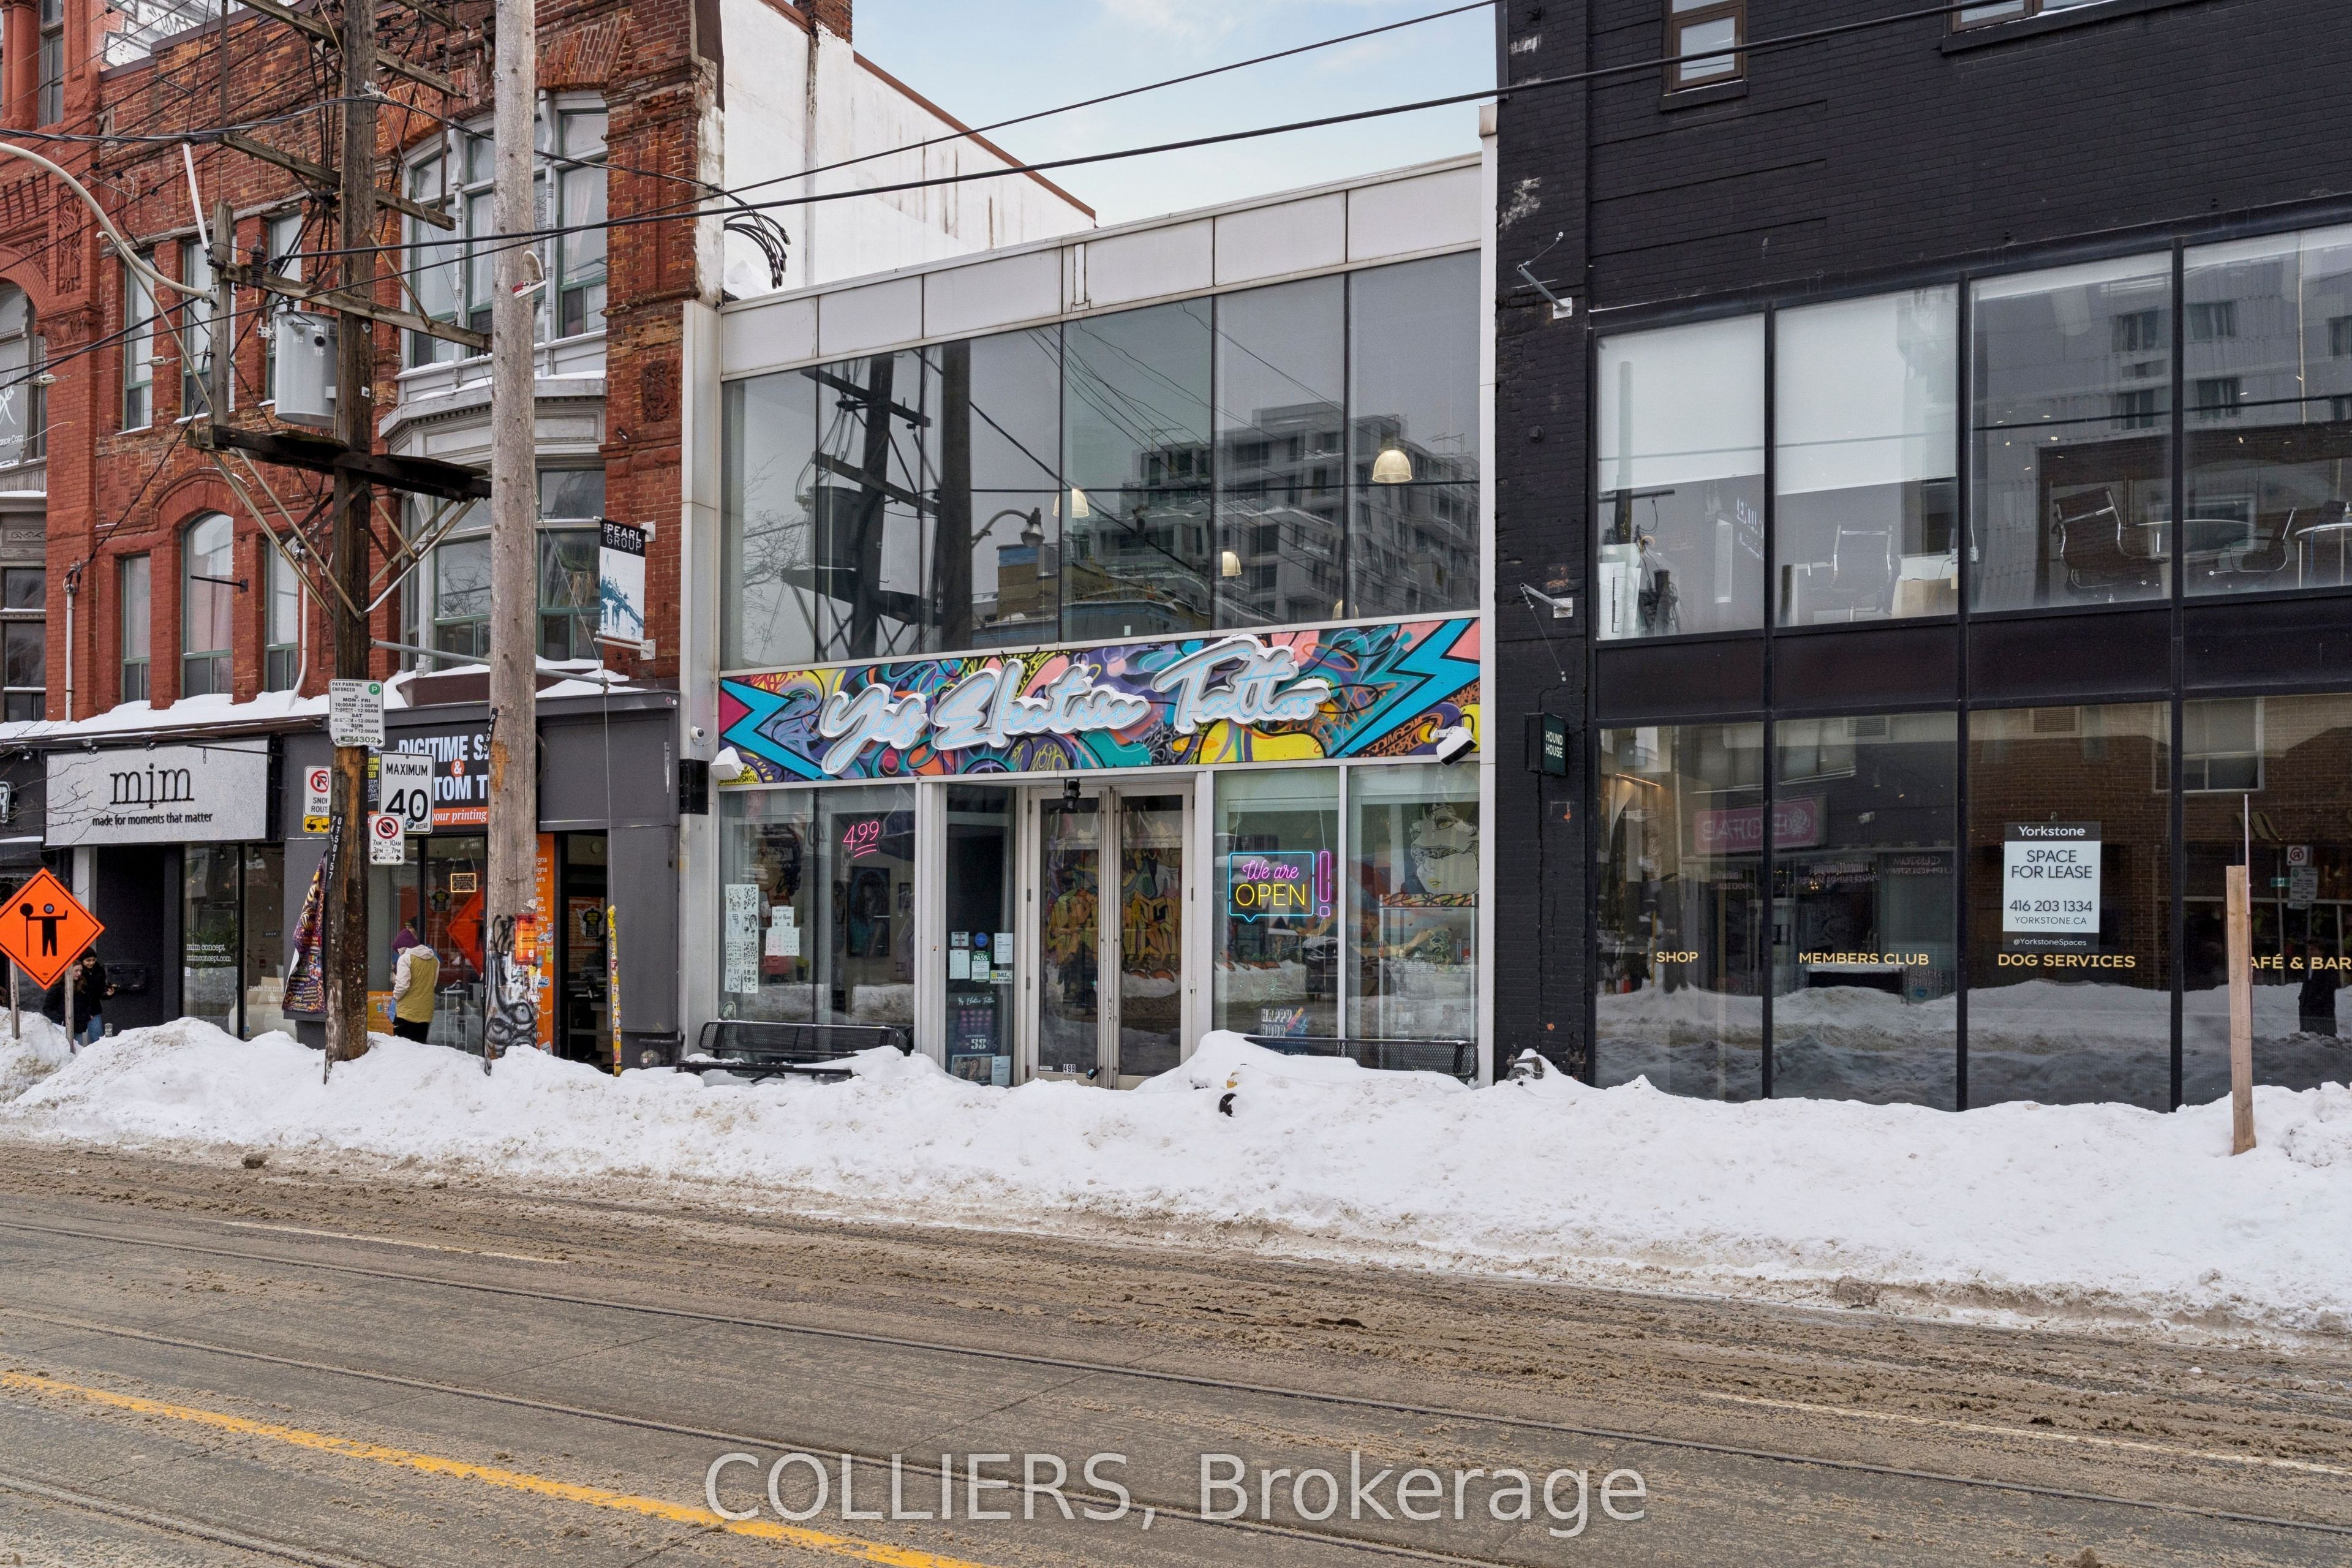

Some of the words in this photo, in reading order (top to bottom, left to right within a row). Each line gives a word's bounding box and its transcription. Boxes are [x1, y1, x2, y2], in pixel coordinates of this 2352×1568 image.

[607, 524, 642, 542] PEARL
[607, 534, 642, 551] GROUP
[931, 658, 1151, 750] Electric
[1152, 634, 1331, 734] Tattoo
[1545, 730, 1563, 745] HOUND
[473, 734, 489, 761] S
[1545, 743, 1563, 758] HOUSE
[386, 763, 428, 776] MAXIMUM
[453, 761, 462, 774] &
[110, 763, 195, 810] mim
[434, 775, 472, 801] TOM
[477, 774, 488, 799] T
[385, 789, 428, 822] 40
[92, 815, 113, 826] made
[115, 815, 127, 825] for
[128, 814, 165, 825] moments
[166, 812, 183, 823] that
[185, 813, 213, 823] matter
[452, 810, 487, 823] printing
[842, 820, 880, 850] 499
[2018, 826, 2086, 837] Yorkstone
[2027, 850, 2076, 862] SPACE
[1242, 859, 1270, 880] We
[1273, 864, 1299, 879] are
[2011, 865, 2043, 878] FOR
[2048, 865, 2092, 878] LEASE
[1235, 884, 1305, 906] OPEN
[2010, 900, 2031, 912] 416
[2034, 900, 2059, 912] 203
[2064, 900, 2093, 912] 1334
[2015, 916, 2087, 925] YORKSTONE.CA
[201, 944, 225, 952] concept
[2013, 938, 2087, 946] @YorkstoneSpaces
[1656, 951, 1698, 963] SHOP
[1798, 952, 1879, 965] MEMBERS
[1883, 953, 1929, 965] CLUB
[1998, 954, 2038, 967] DOG
[2043, 954, 2136, 968] SERVICES
[2251, 953, 2284, 969] AFÉ
[2290, 957, 2304, 970] &
[2311, 957, 2352, 970] BAR
[1261, 1008, 1292, 1023] HAPPY
[1261, 1023, 1286, 1037] HOUR
